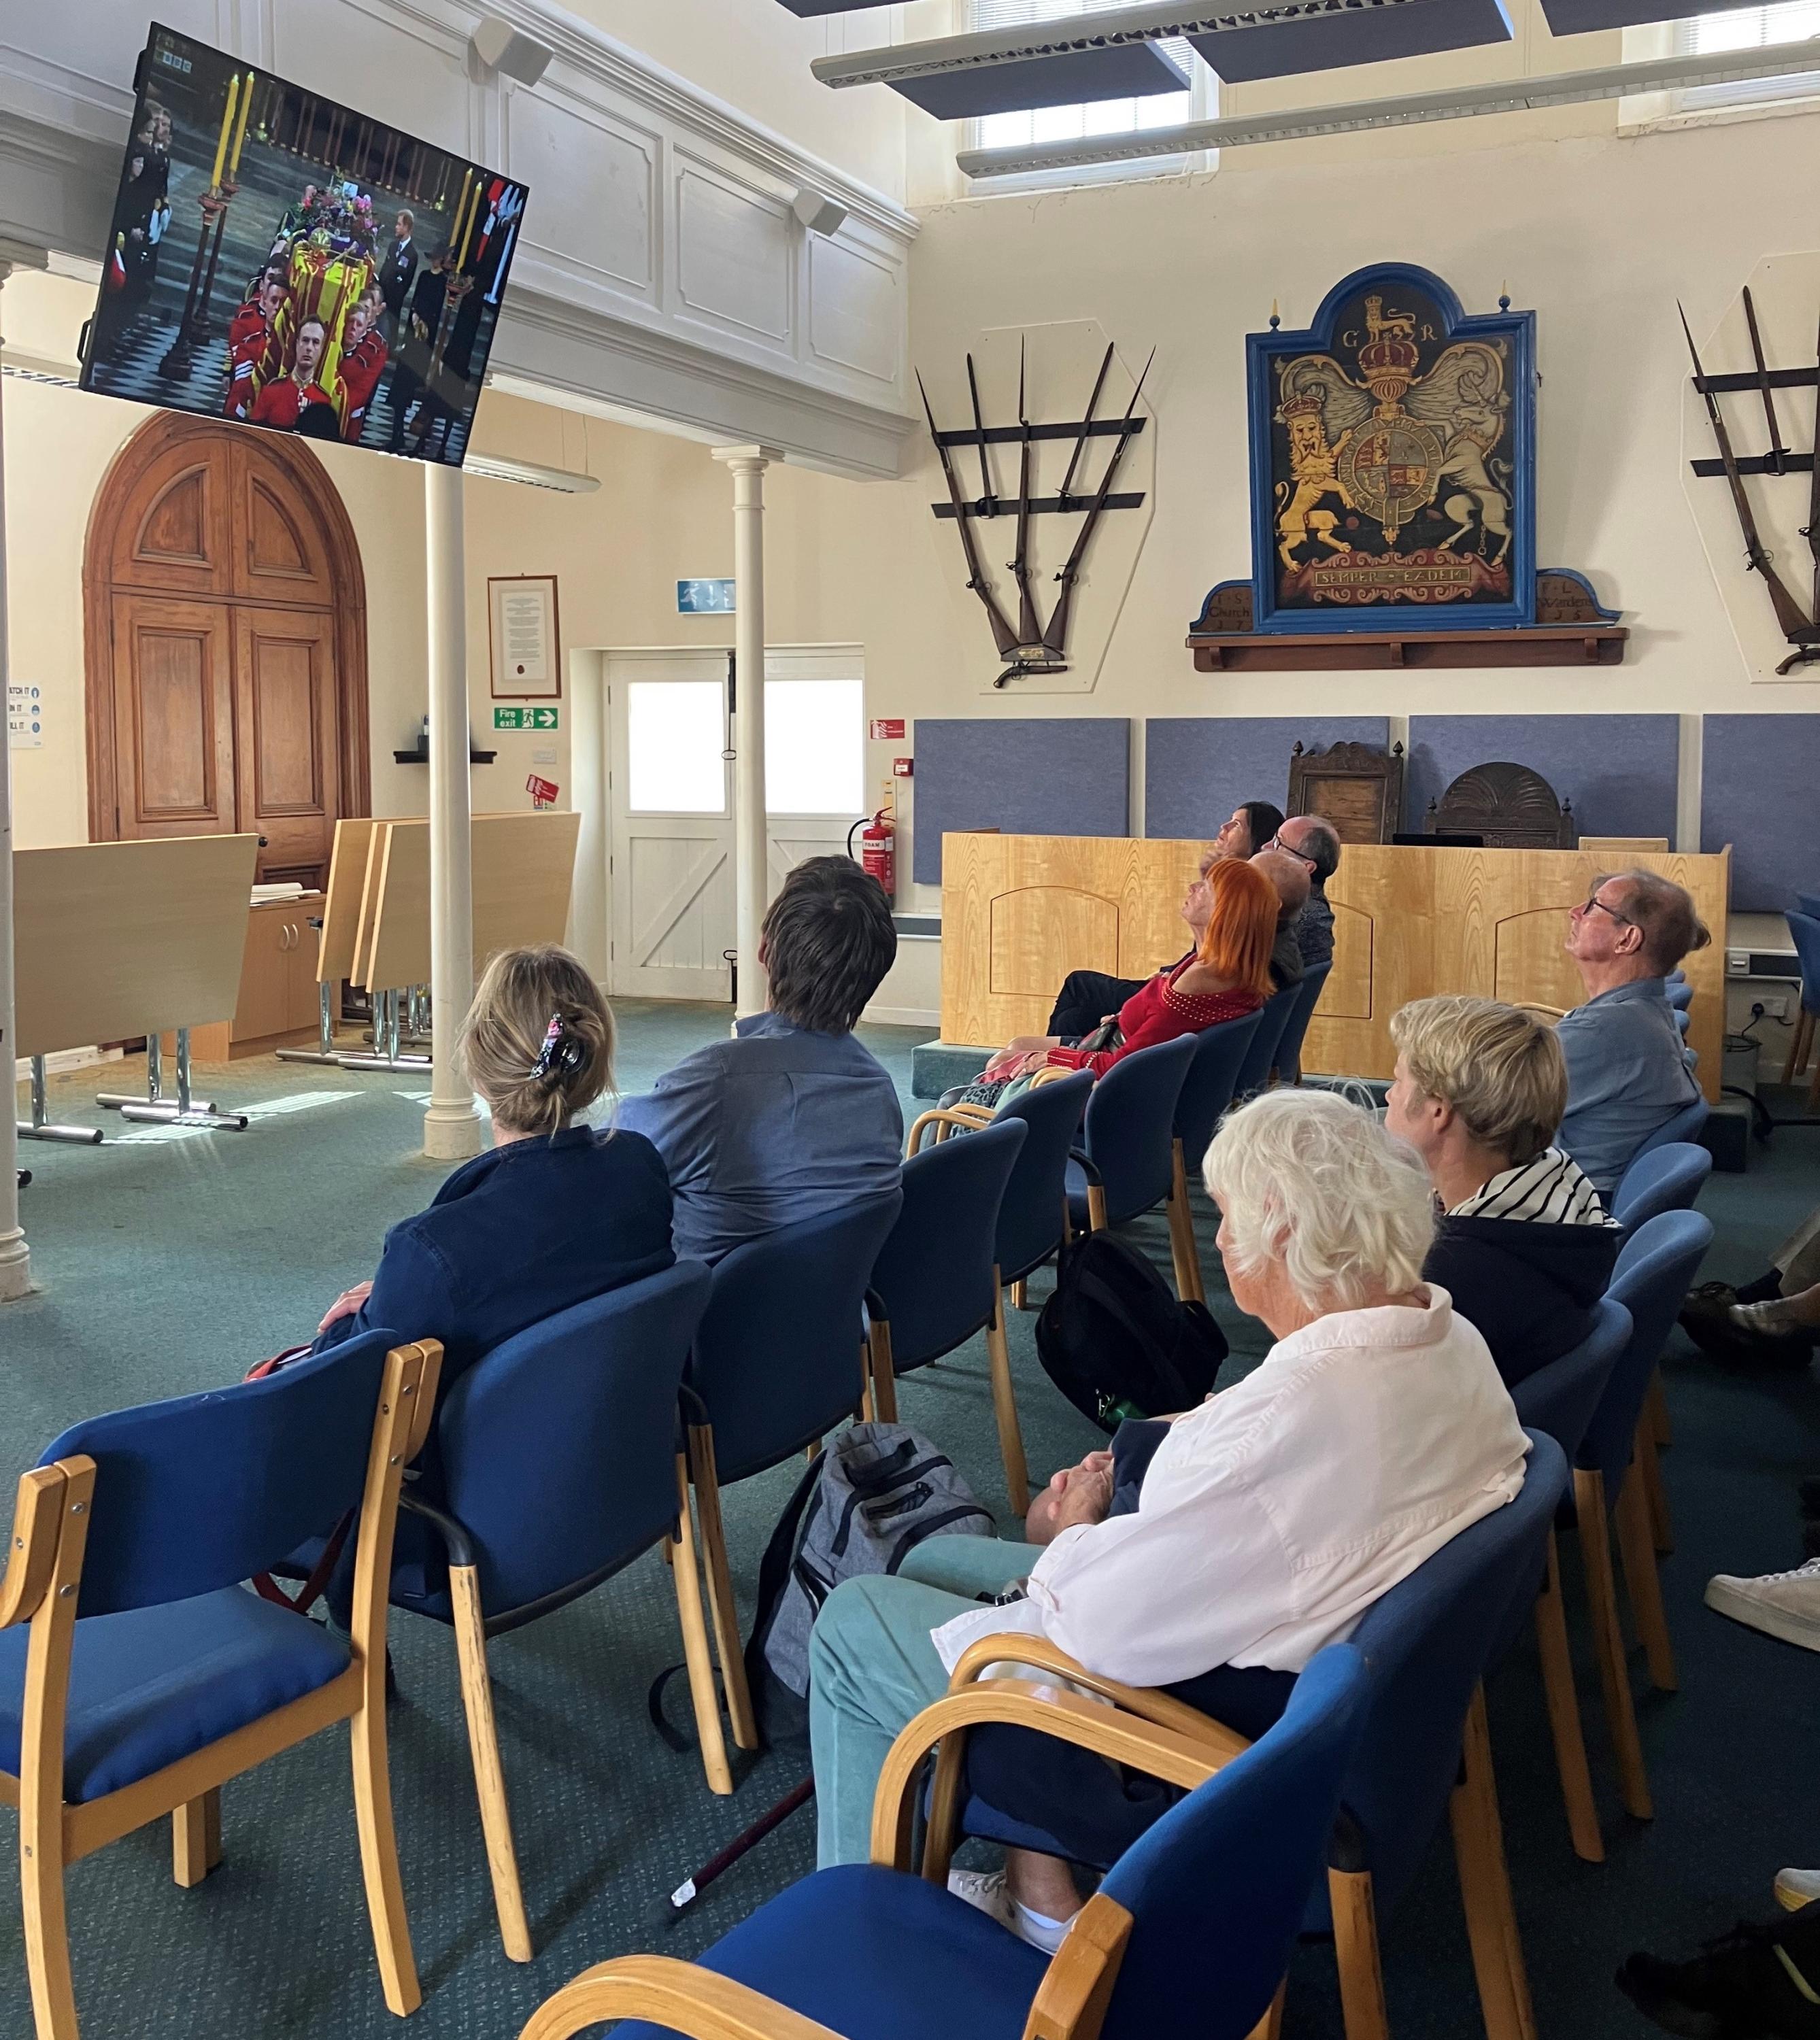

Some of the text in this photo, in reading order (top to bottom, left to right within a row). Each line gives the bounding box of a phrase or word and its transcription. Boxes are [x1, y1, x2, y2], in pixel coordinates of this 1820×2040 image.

[163, 52, 192, 73] BBC
[1343, 324, 1438, 347] G R
[1322, 570, 1462, 583] SEMPER EADEM
[499, 709, 516, 718] Fire
[499, 718, 516, 728] exit
